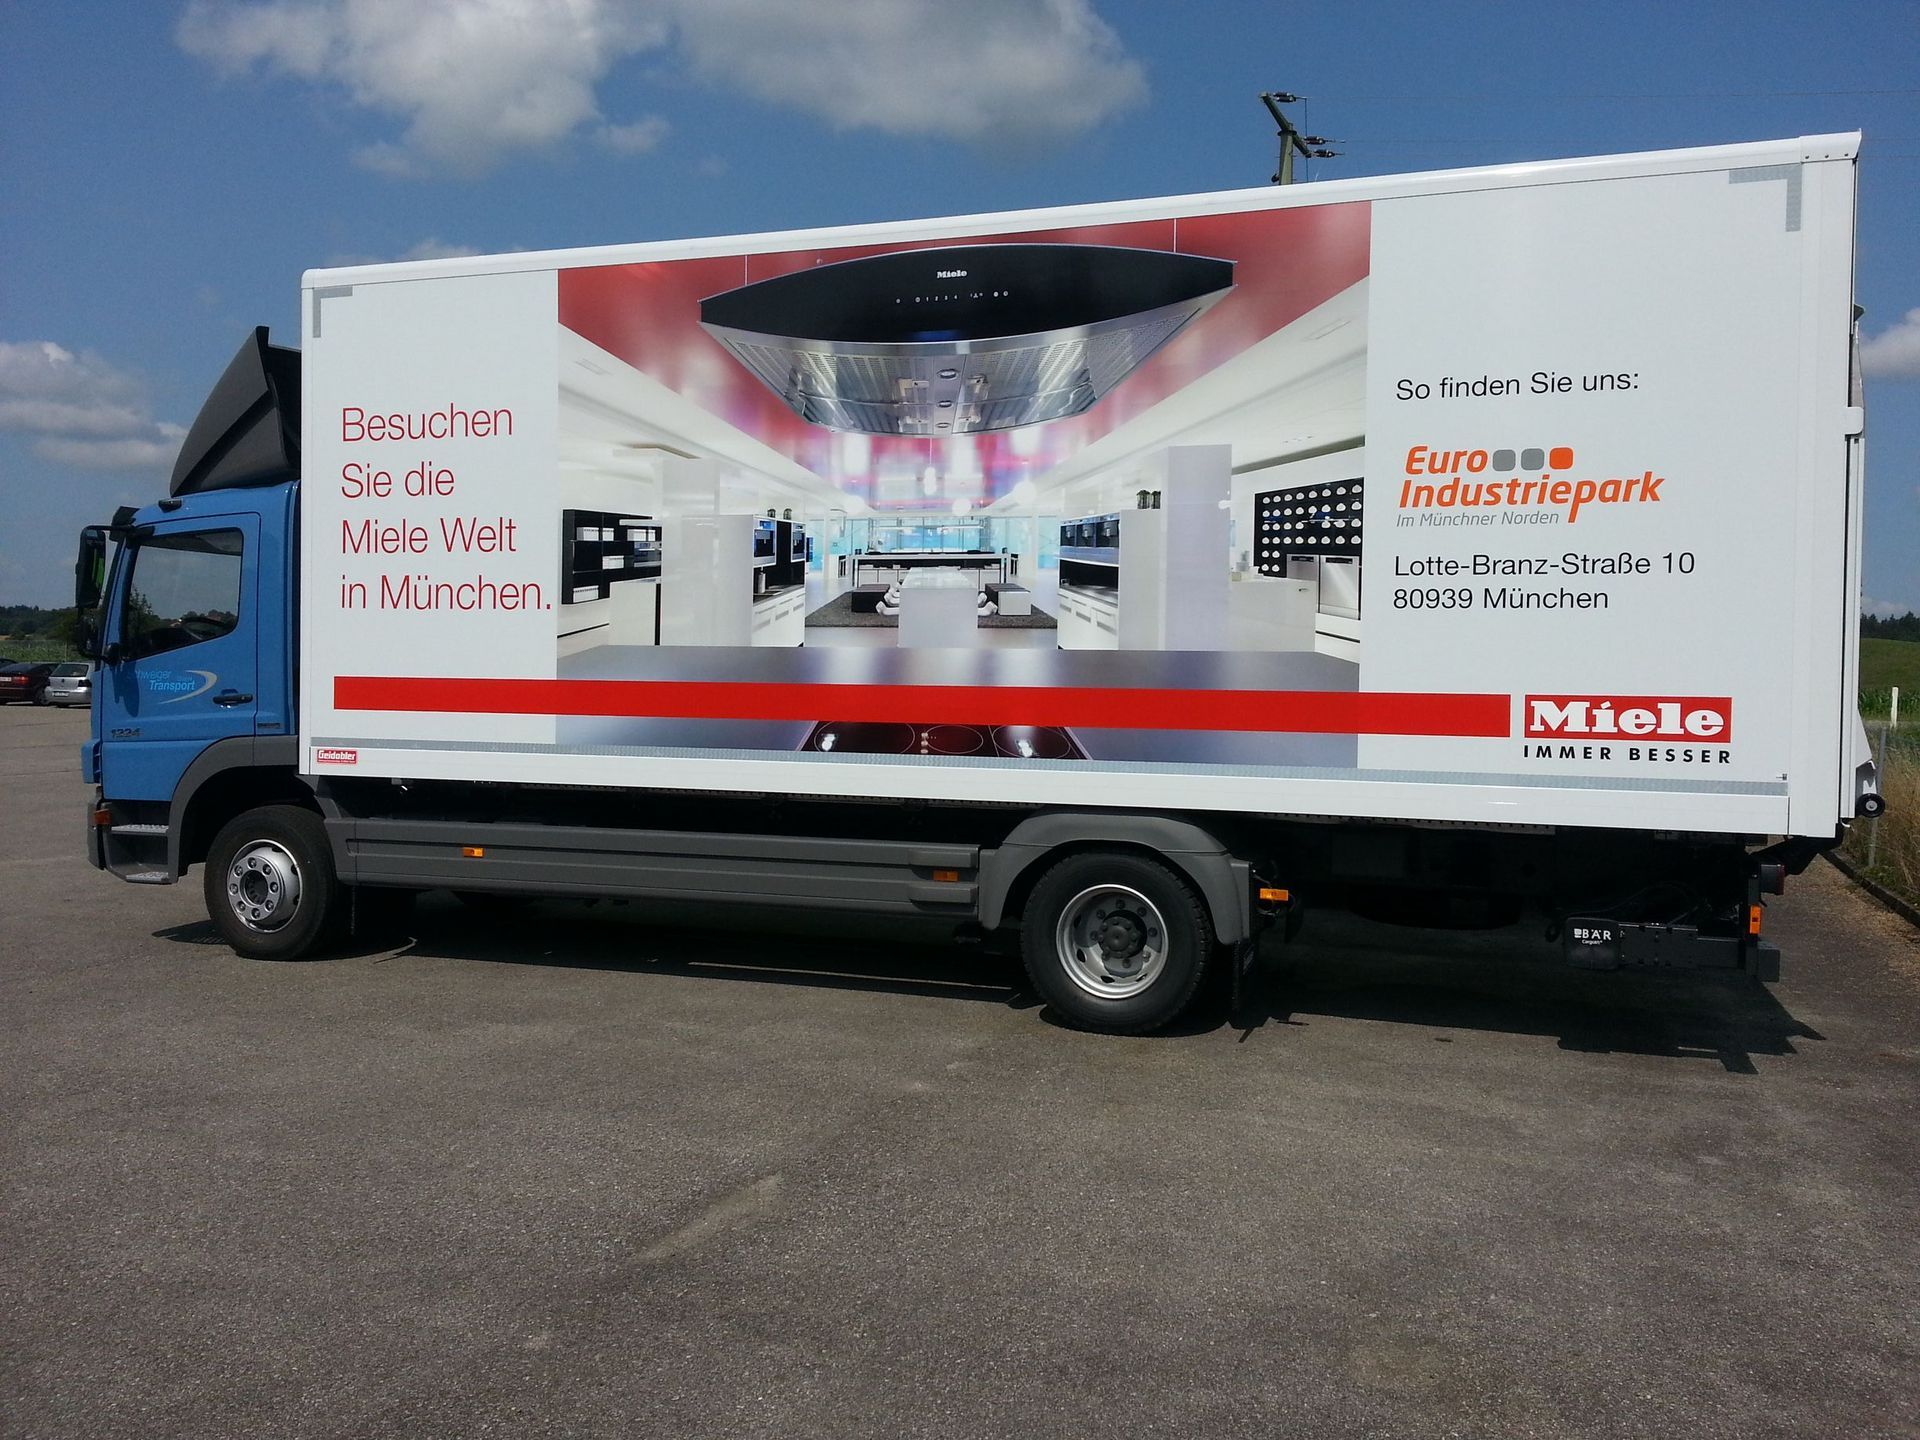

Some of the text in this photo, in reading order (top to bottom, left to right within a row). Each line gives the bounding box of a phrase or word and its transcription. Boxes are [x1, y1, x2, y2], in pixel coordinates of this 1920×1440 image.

[936, 270, 967, 279] Miele
[1397, 372, 1638, 400] So finden Sie uns:
[343, 403, 512, 441] Besuchen
[1406, 446, 1488, 474] Euro
[342, 461, 454, 498] Sie die
[1399, 471, 1665, 523] Industriepark
[1397, 510, 1559, 527] Im Münchner Norden
[343, 517, 516, 553] Miele Welt
[1396, 553, 1694, 576] Lotte-Branz-Straße 10
[342, 575, 550, 610] in München.
[1394, 588, 1608, 609] 80939 München
[149, 680, 195, 692] Transport
[1530, 700, 1724, 736] Miele
[1523, 745, 1731, 764] IMMER BESSER
[1582, 929, 1612, 940] BÄR
